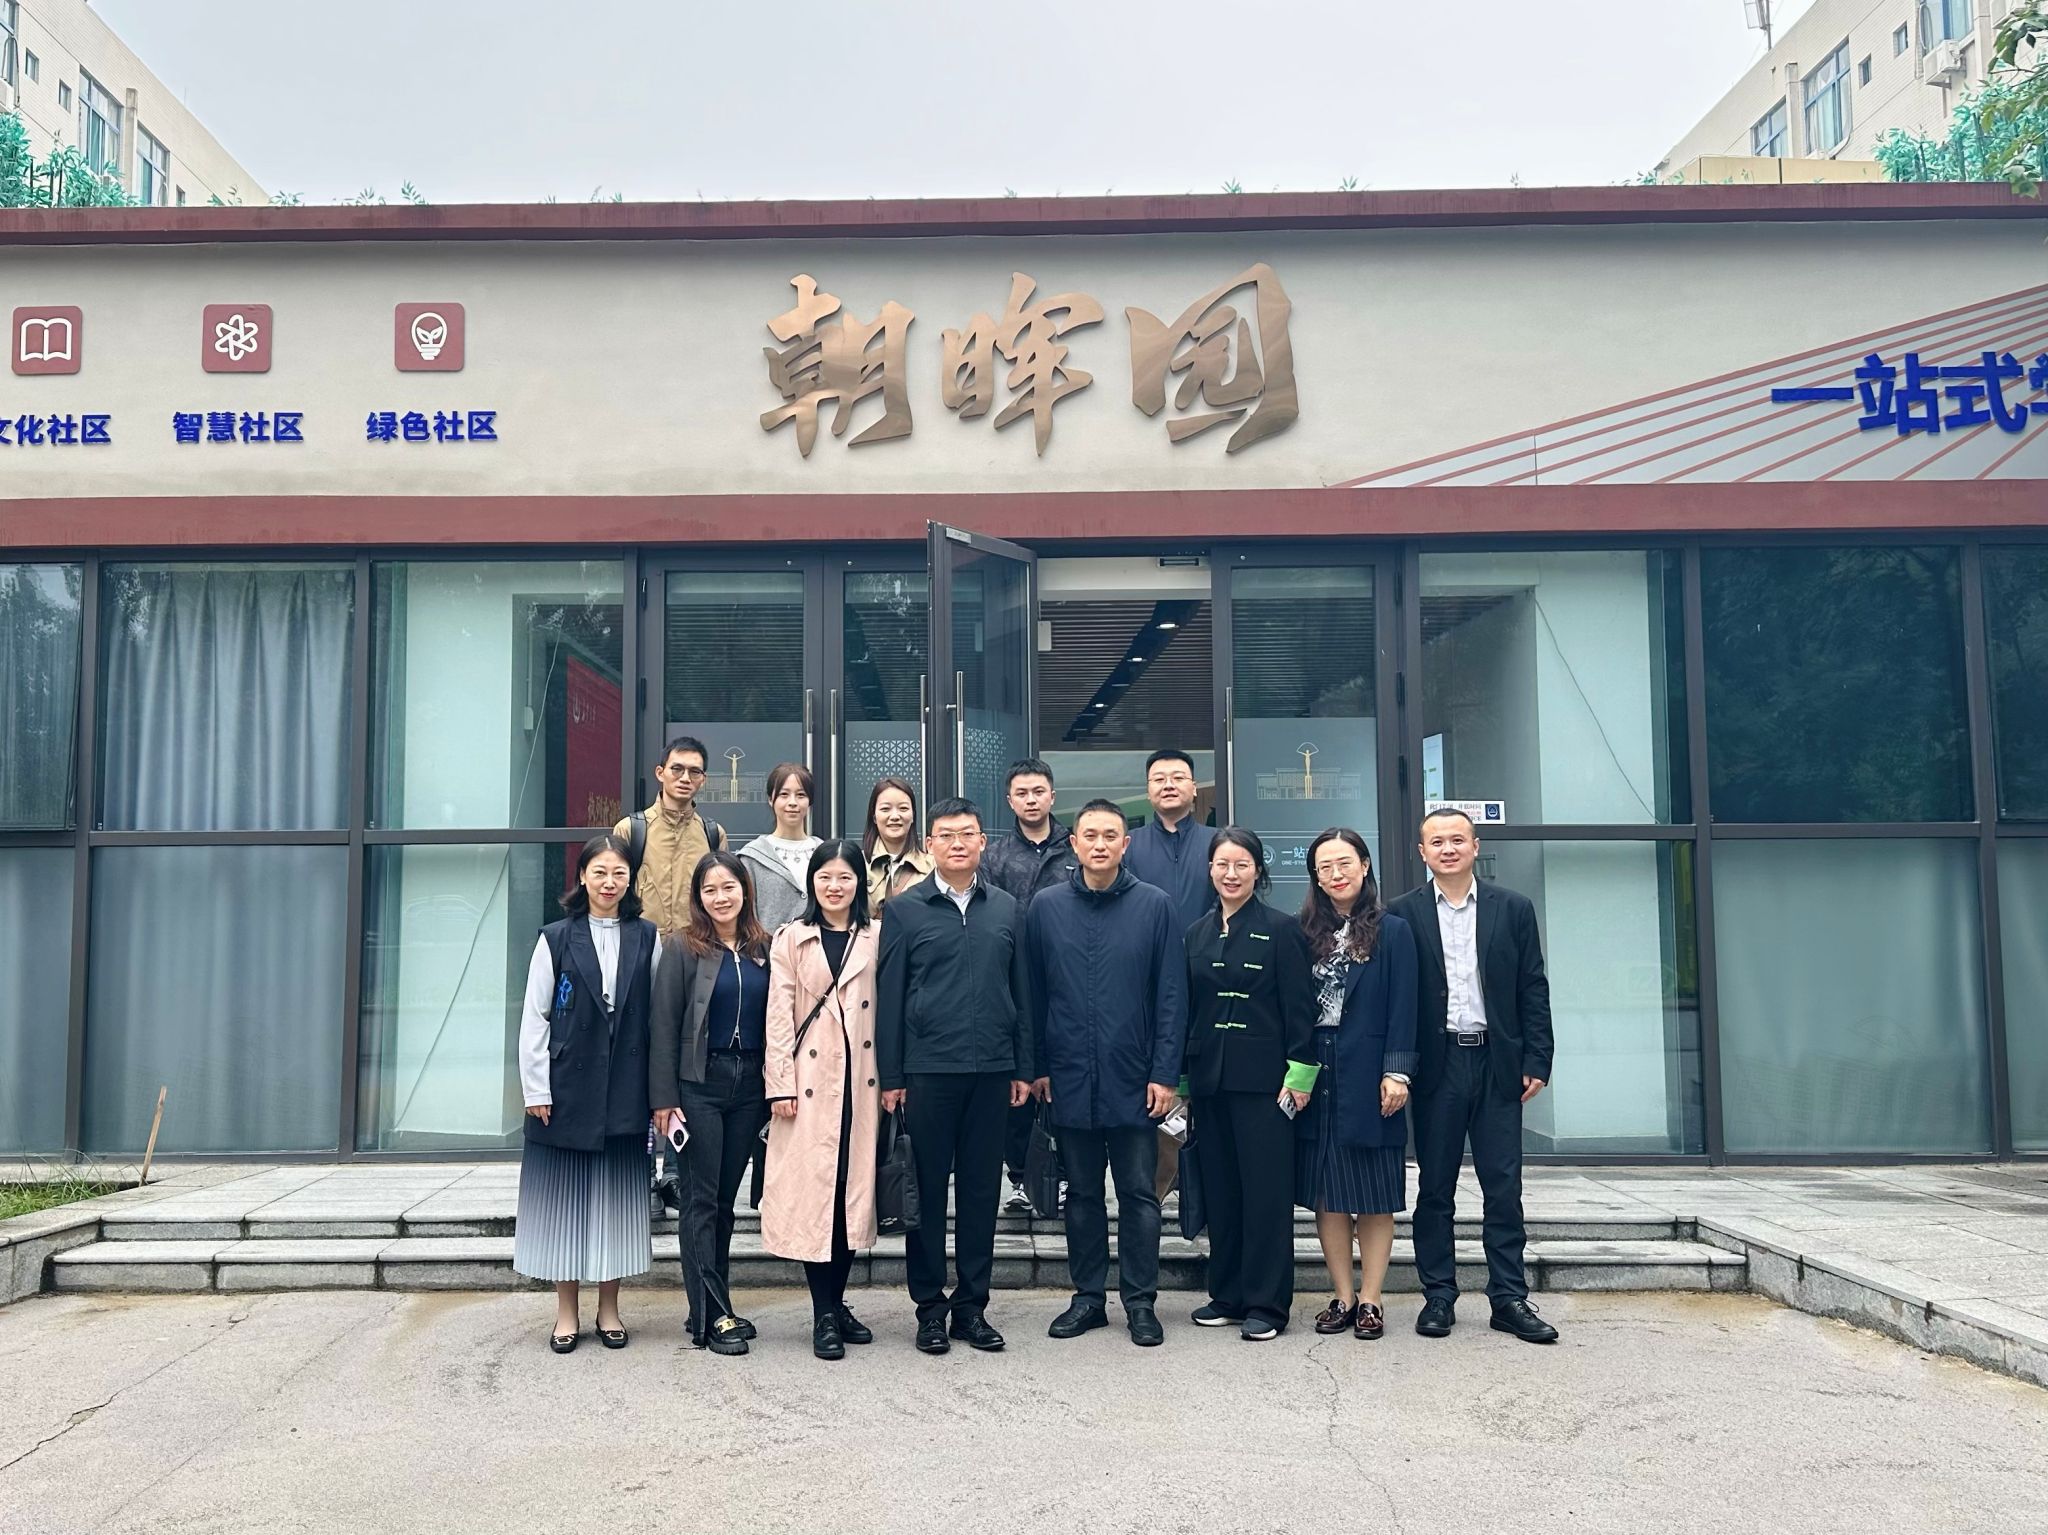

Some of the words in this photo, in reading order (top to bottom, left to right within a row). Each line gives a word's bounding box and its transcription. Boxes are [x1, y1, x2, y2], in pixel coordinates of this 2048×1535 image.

[760, 262, 1300, 457] 朝晖园
[1771, 352, 2048, 436] 一站式
[173, 411, 304, 444] 智慧社区
[366, 410, 498, 442] 绿色社区
[1281, 846, 1309, 859] 一站
